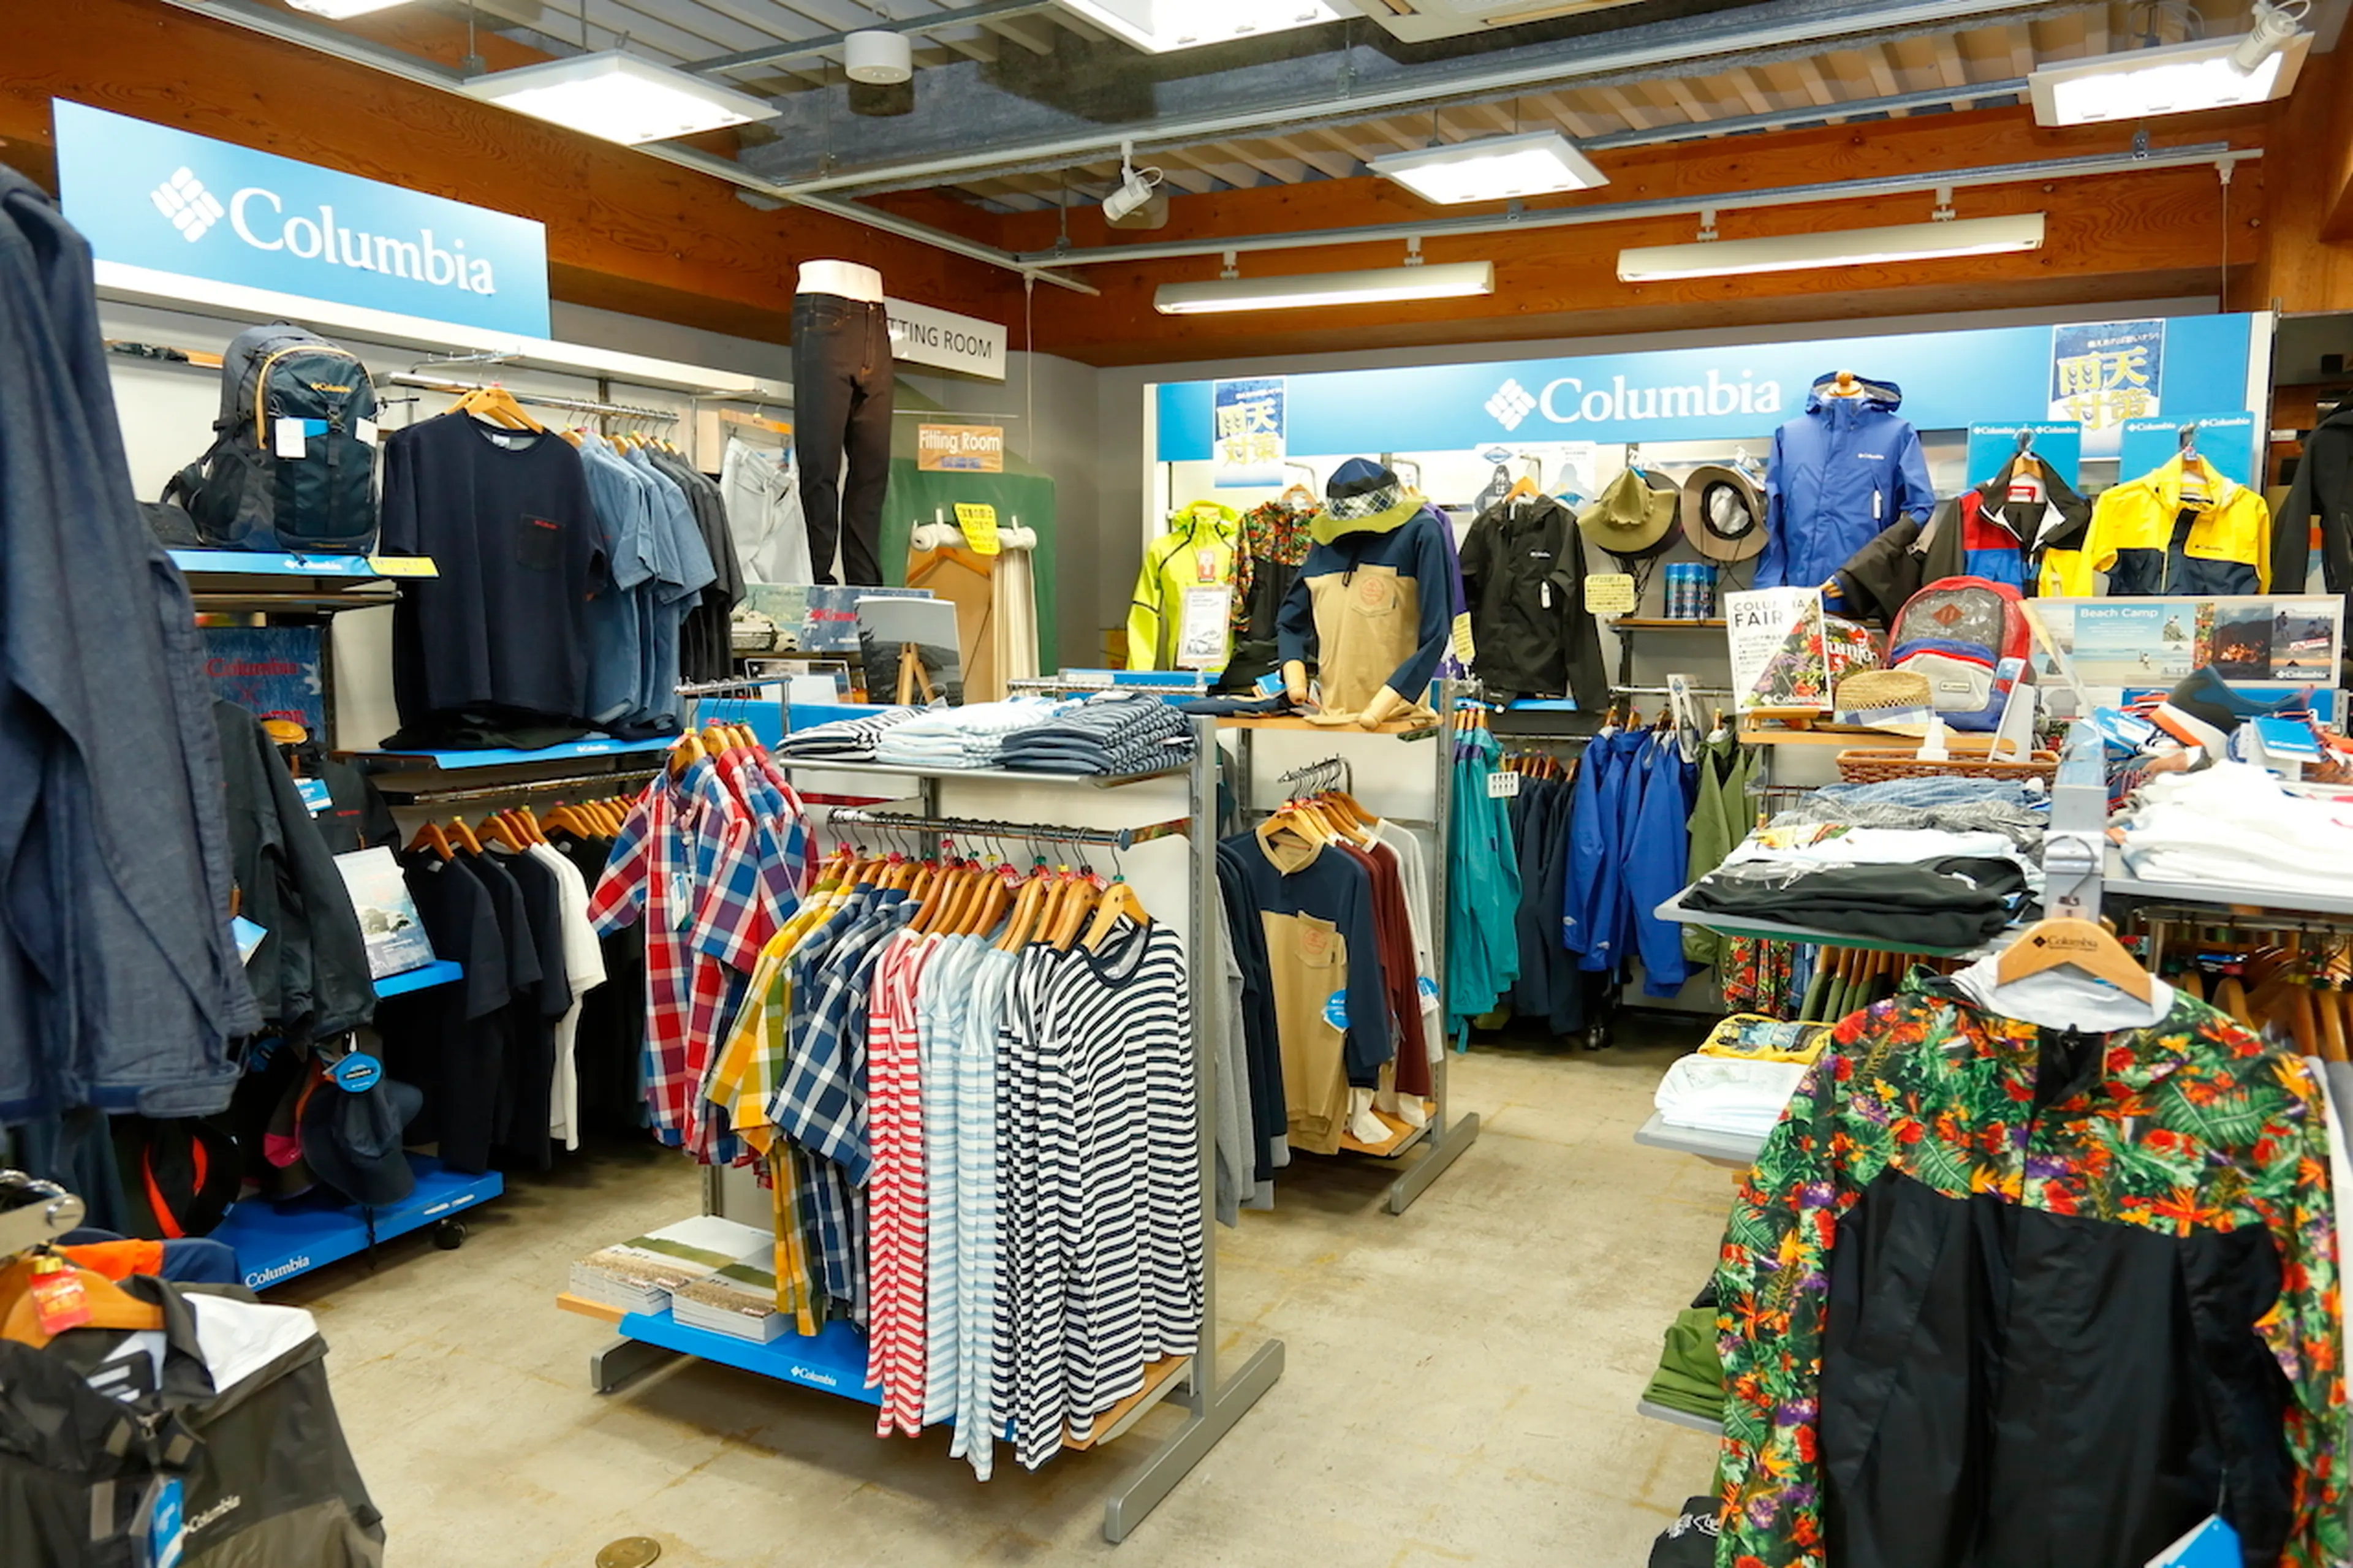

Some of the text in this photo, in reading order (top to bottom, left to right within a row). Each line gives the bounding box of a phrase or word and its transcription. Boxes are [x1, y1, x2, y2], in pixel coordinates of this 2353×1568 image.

[230, 187, 497, 295] Columbia
[887, 317, 991, 359] TTING ROOM
[2056, 346, 2150, 396] 雨天
[1539, 369, 1782, 424] Columbia
[1216, 396, 1278, 438] 雨天
[919, 430, 1000, 455] Fitting Room
[1733, 598, 1805, 612] COLUIA
[1735, 610, 1784, 627] FAIR
[2080, 607, 2159, 619] Beach Camp
[204, 657, 300, 678] Columbia
[2047, 934, 2098, 947] Columbia
[245, 1256, 311, 1289] Columbia
[799, 1368, 837, 1387] Columbia
[188, 1495, 241, 1533] Columbia
